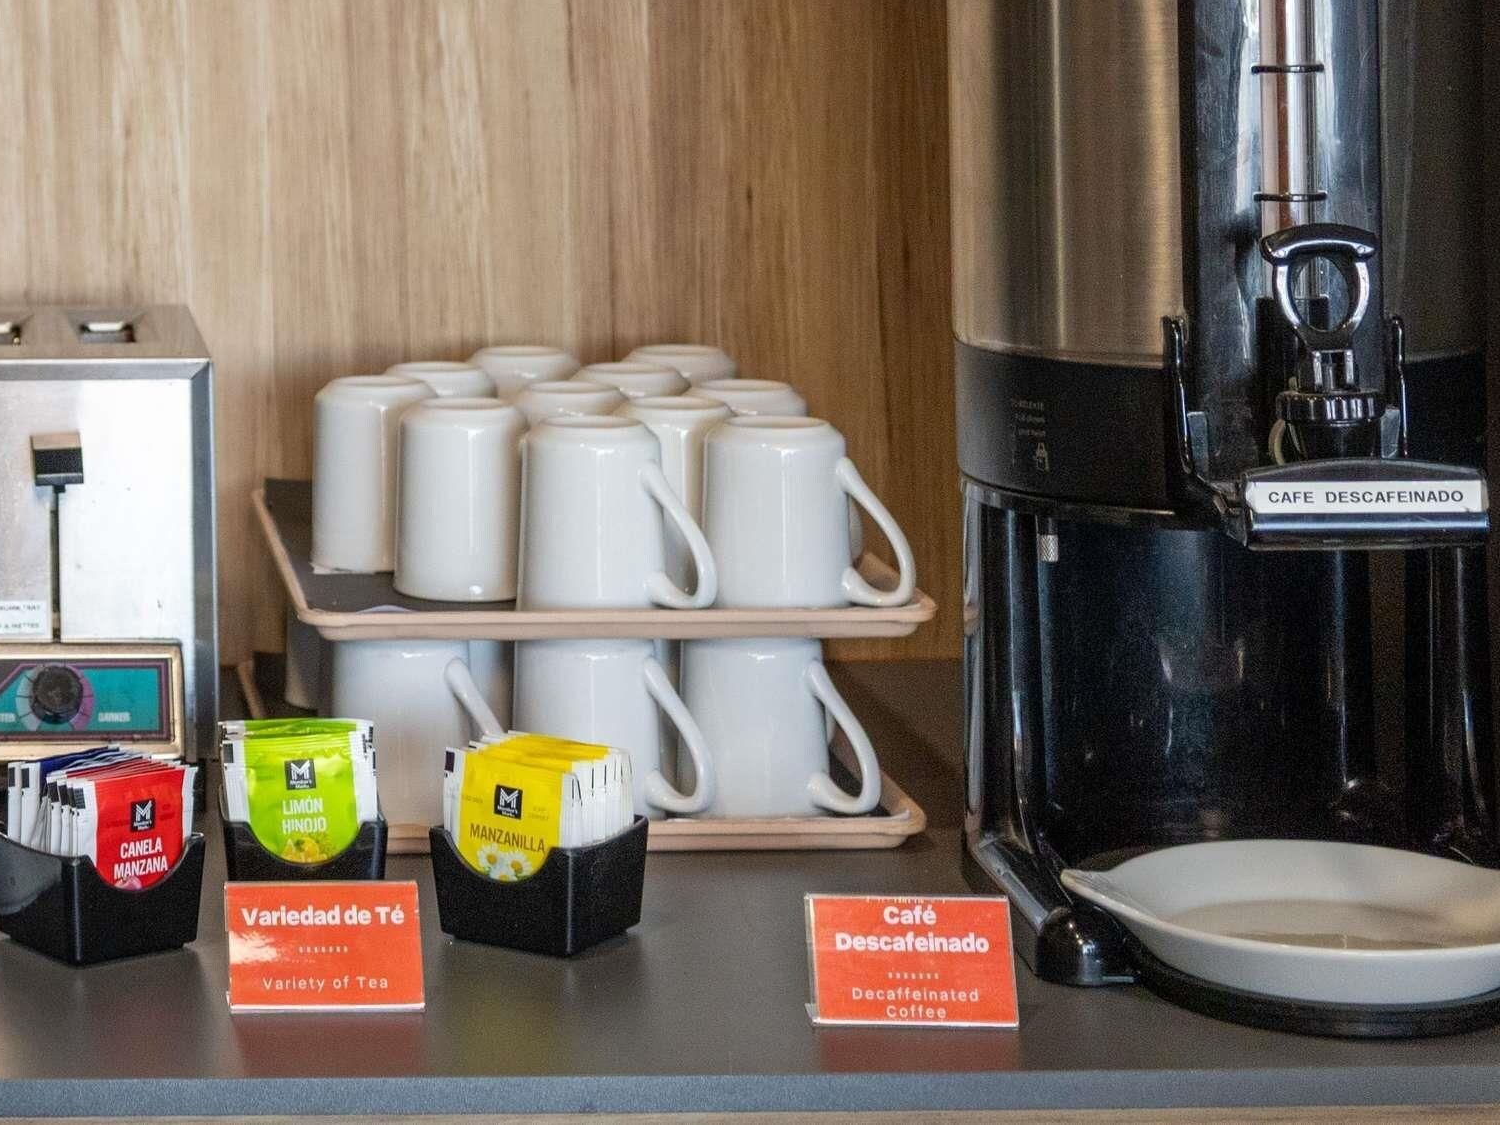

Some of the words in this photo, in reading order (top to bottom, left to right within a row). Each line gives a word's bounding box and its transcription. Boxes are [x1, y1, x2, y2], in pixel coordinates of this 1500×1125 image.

[1267, 490, 1315, 504] CAFE
[1325, 489, 1464, 504] DESCAFEINADO
[98, 711, 131, 723] DARKER
[281, 795, 324, 816] LIMÓN
[281, 816, 328, 835] HINOJO
[119, 836, 163, 860] CANELA
[469, 822, 546, 853] MANZANILLA
[113, 855, 169, 881] MANZANA
[240, 904, 341, 926] Variedad
[343, 903, 373, 925] de
[374, 902, 406, 925] Té
[883, 904, 937, 925] Café
[834, 931, 991, 954] Descafeinado
[262, 976, 326, 991] Variety
[332, 976, 351, 990] of
[355, 975, 389, 989] Tea
[851, 986, 980, 1002] Decaffeinated
[885, 1004, 948, 1019] Coffee
